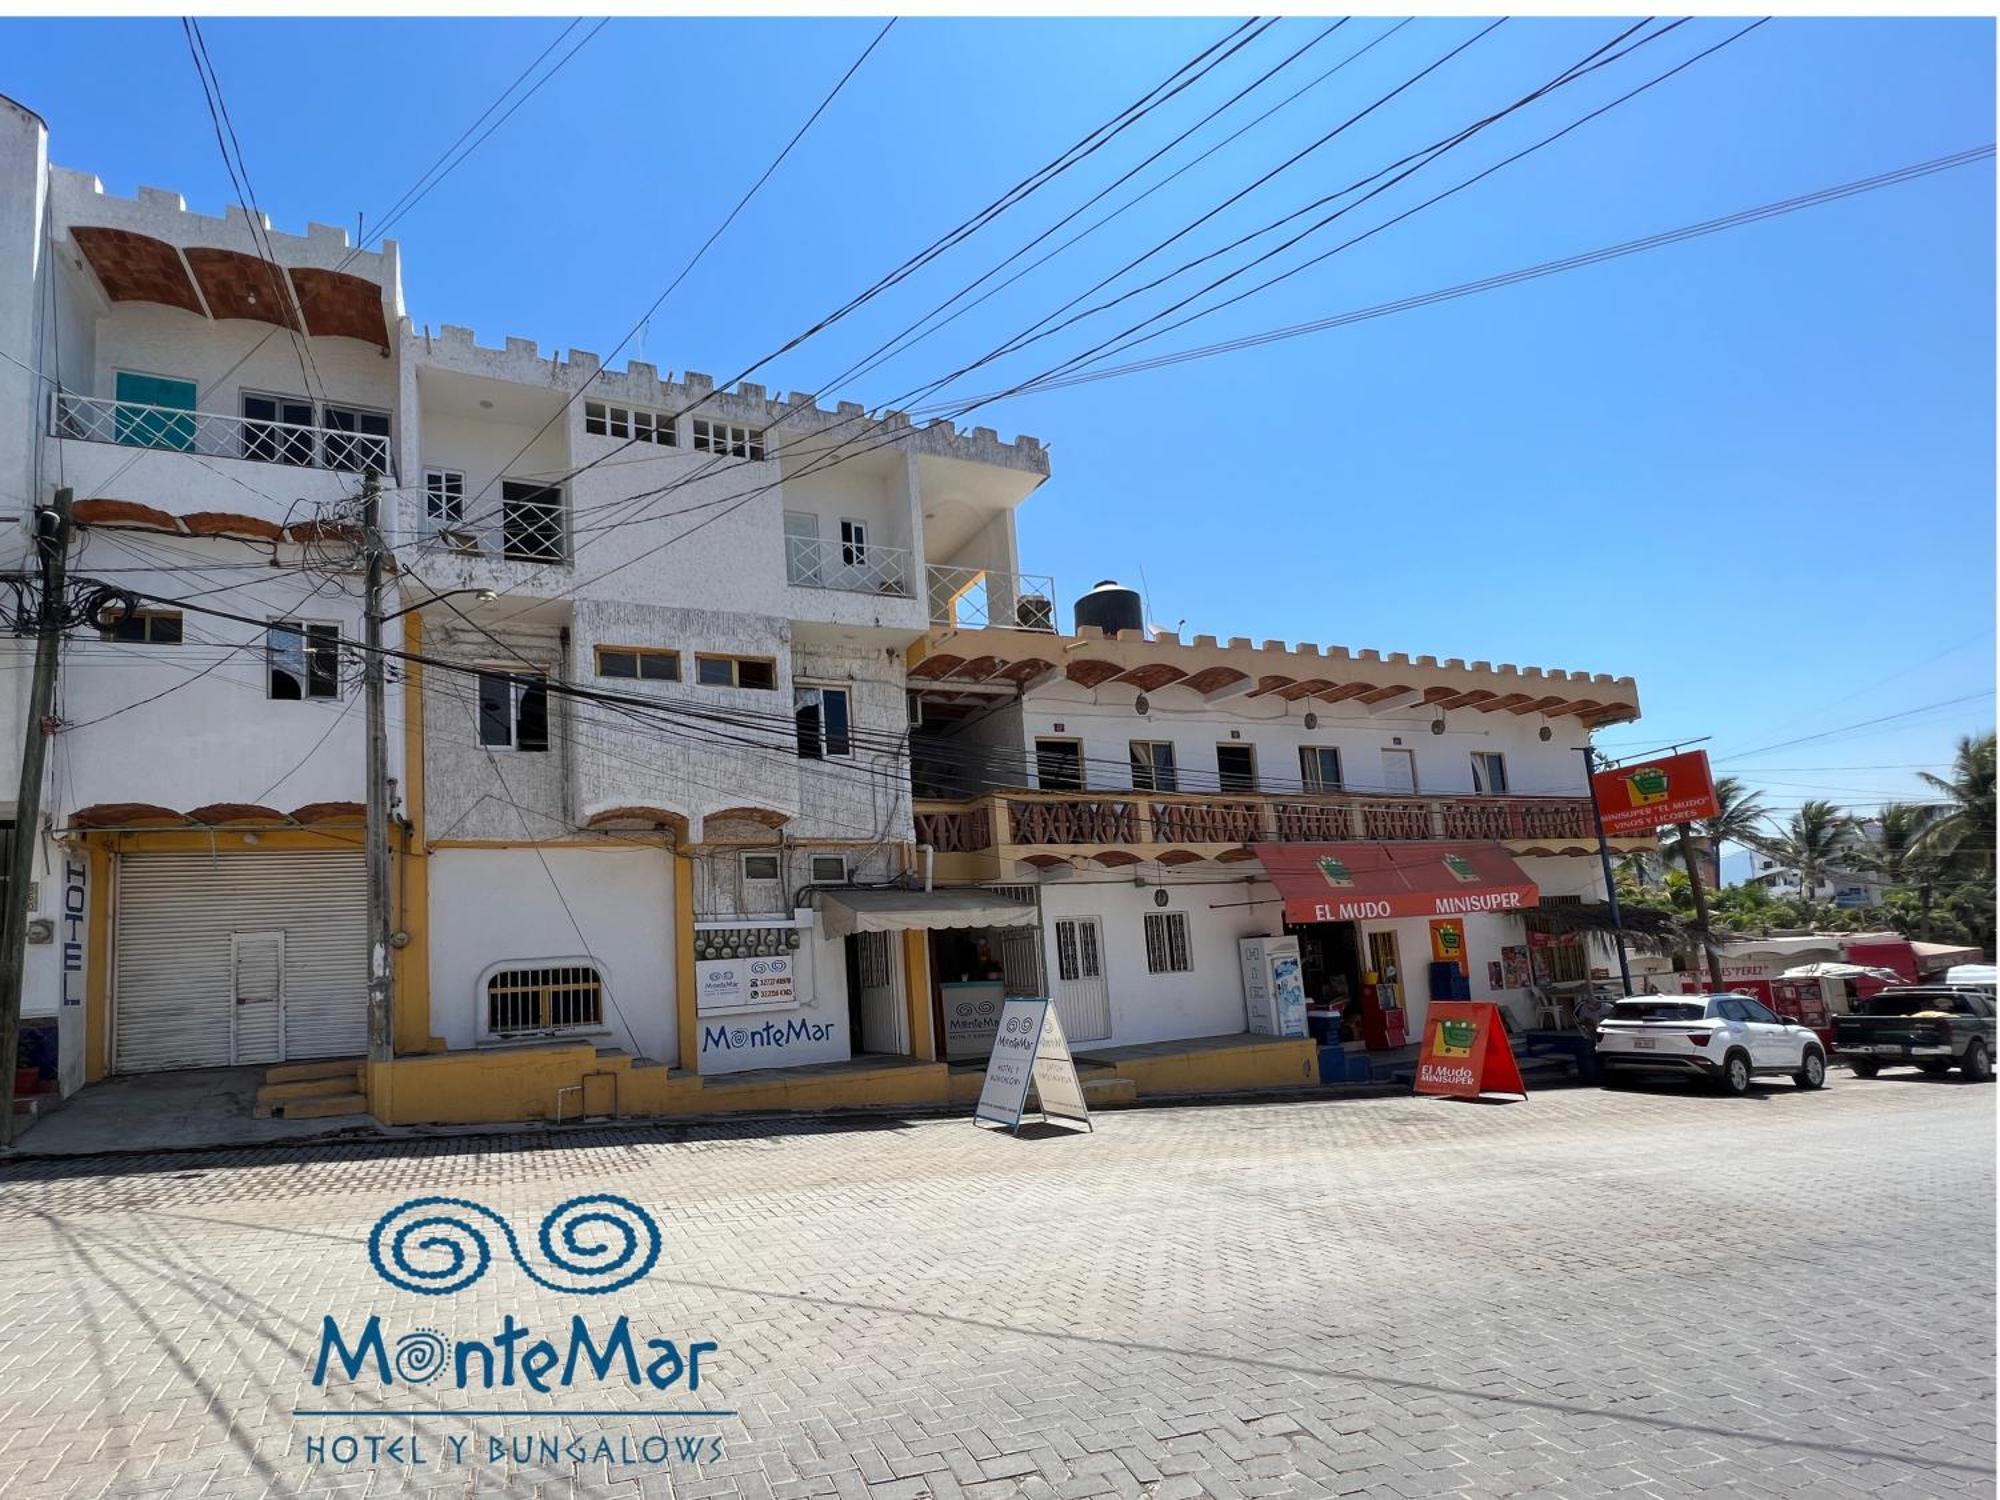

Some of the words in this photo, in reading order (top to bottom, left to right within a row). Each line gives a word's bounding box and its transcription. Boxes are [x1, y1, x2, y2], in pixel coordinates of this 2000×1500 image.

[1614, 819, 1644, 829] VINOS
[1655, 810, 1698, 823] LICORES
[1315, 904, 1336, 921] EL
[1339, 900, 1392, 920] MUDO
[1435, 891, 1521, 915] MINISUPER
[64, 860, 86, 1006] HOTEL
[702, 1018, 835, 1053] MonteMar
[1421, 1073, 1475, 1085] MINISUPER
[1422, 1064, 1433, 1075] El
[1435, 1065, 1473, 1078] Mudo
